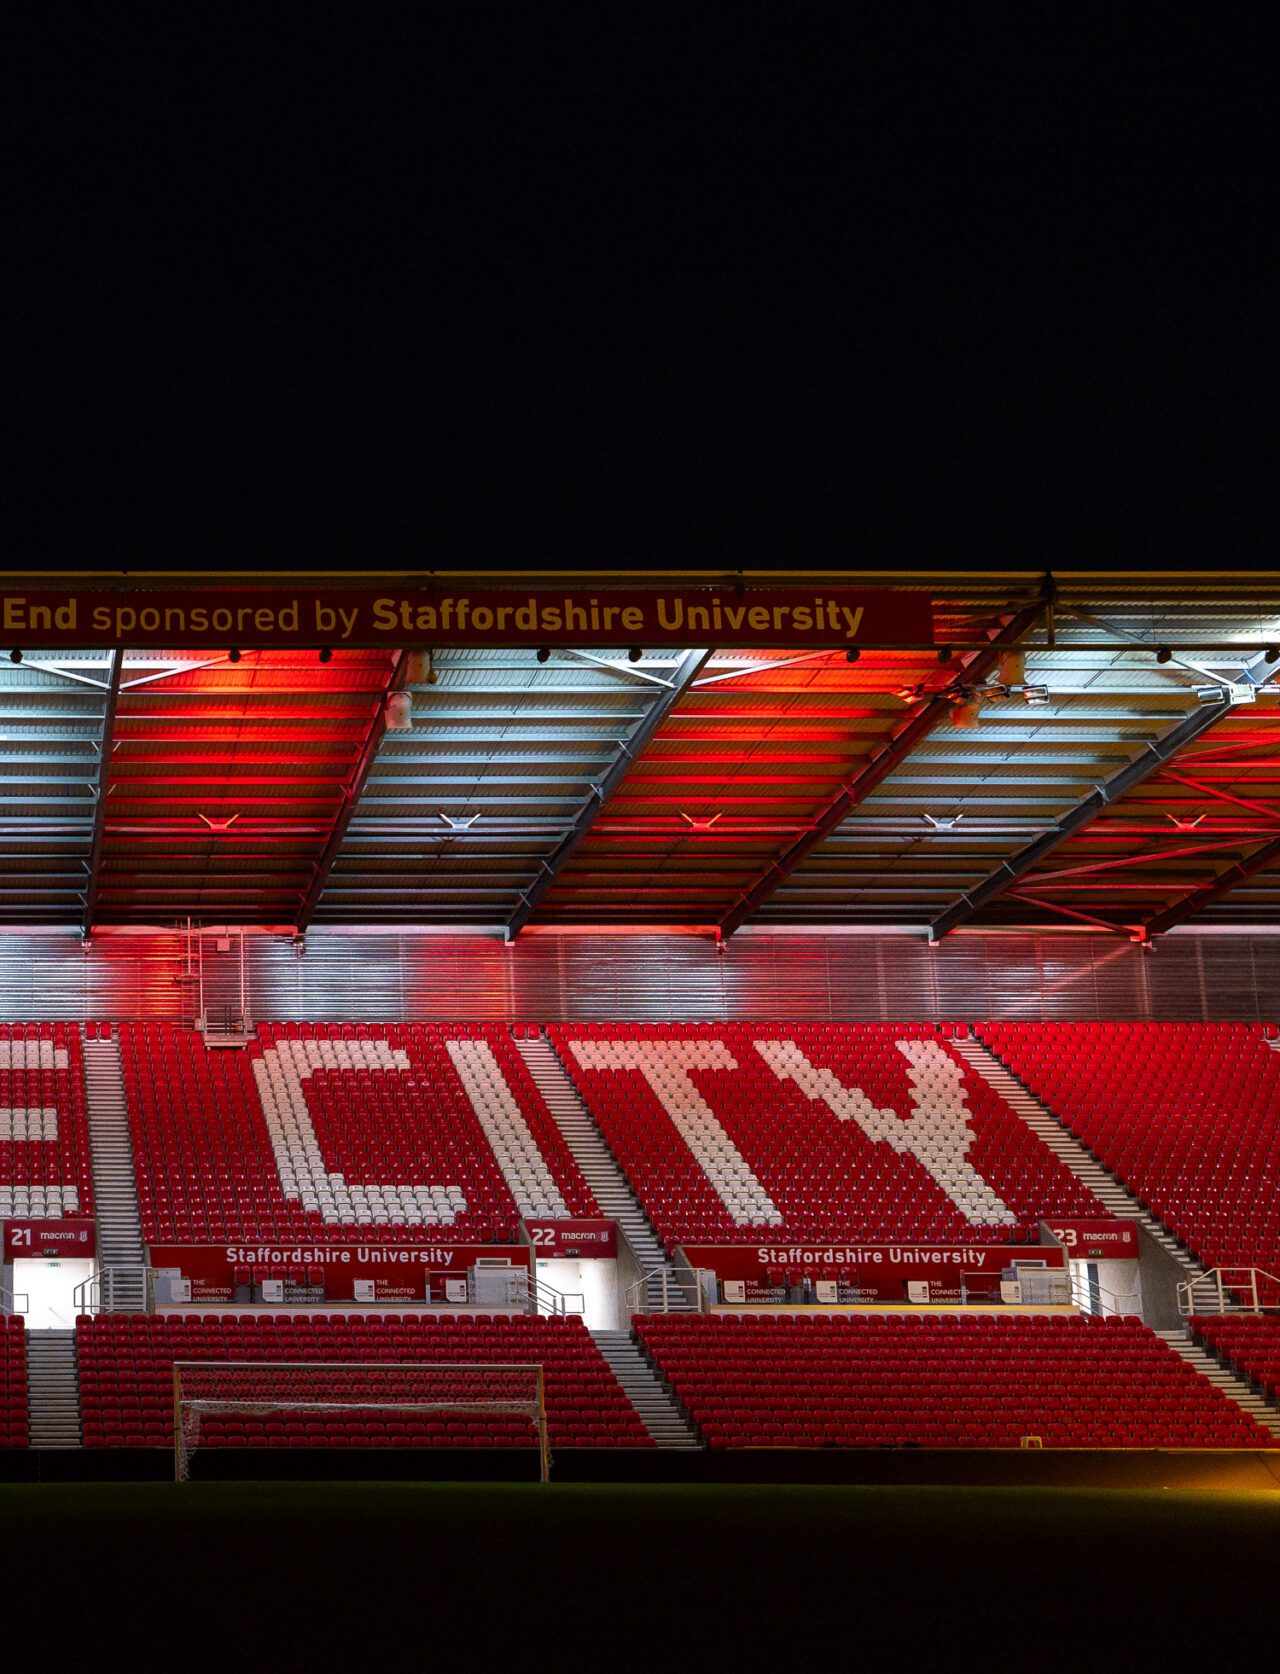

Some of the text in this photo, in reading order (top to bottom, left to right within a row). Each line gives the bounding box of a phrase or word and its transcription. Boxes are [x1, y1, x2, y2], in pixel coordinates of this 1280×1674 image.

[2, 597, 78, 630] End
[91, 599, 299, 638] sponsored
[315, 599, 359, 638] by
[371, 597, 644, 631] Staffordshire
[656, 597, 865, 638] University
[250, 1038, 1019, 1226] CITY
[10, 1228, 75, 1246] 21 macron
[531, 1228, 596, 1246] 22 macron
[1083, 1232, 1118, 1241] macron
[226, 1247, 454, 1266] Staffordshire University
[757, 1247, 986, 1267] Staffordshire University
[192, 1287, 232, 1295] CONNECTED
[284, 1287, 324, 1295] CONNECTED
[376, 1287, 416, 1295] CONNECTED
[746, 1288, 786, 1296] CONNECTED
[838, 1288, 878, 1296] CONNECTED
[930, 1288, 970, 1296] CONNECTD
